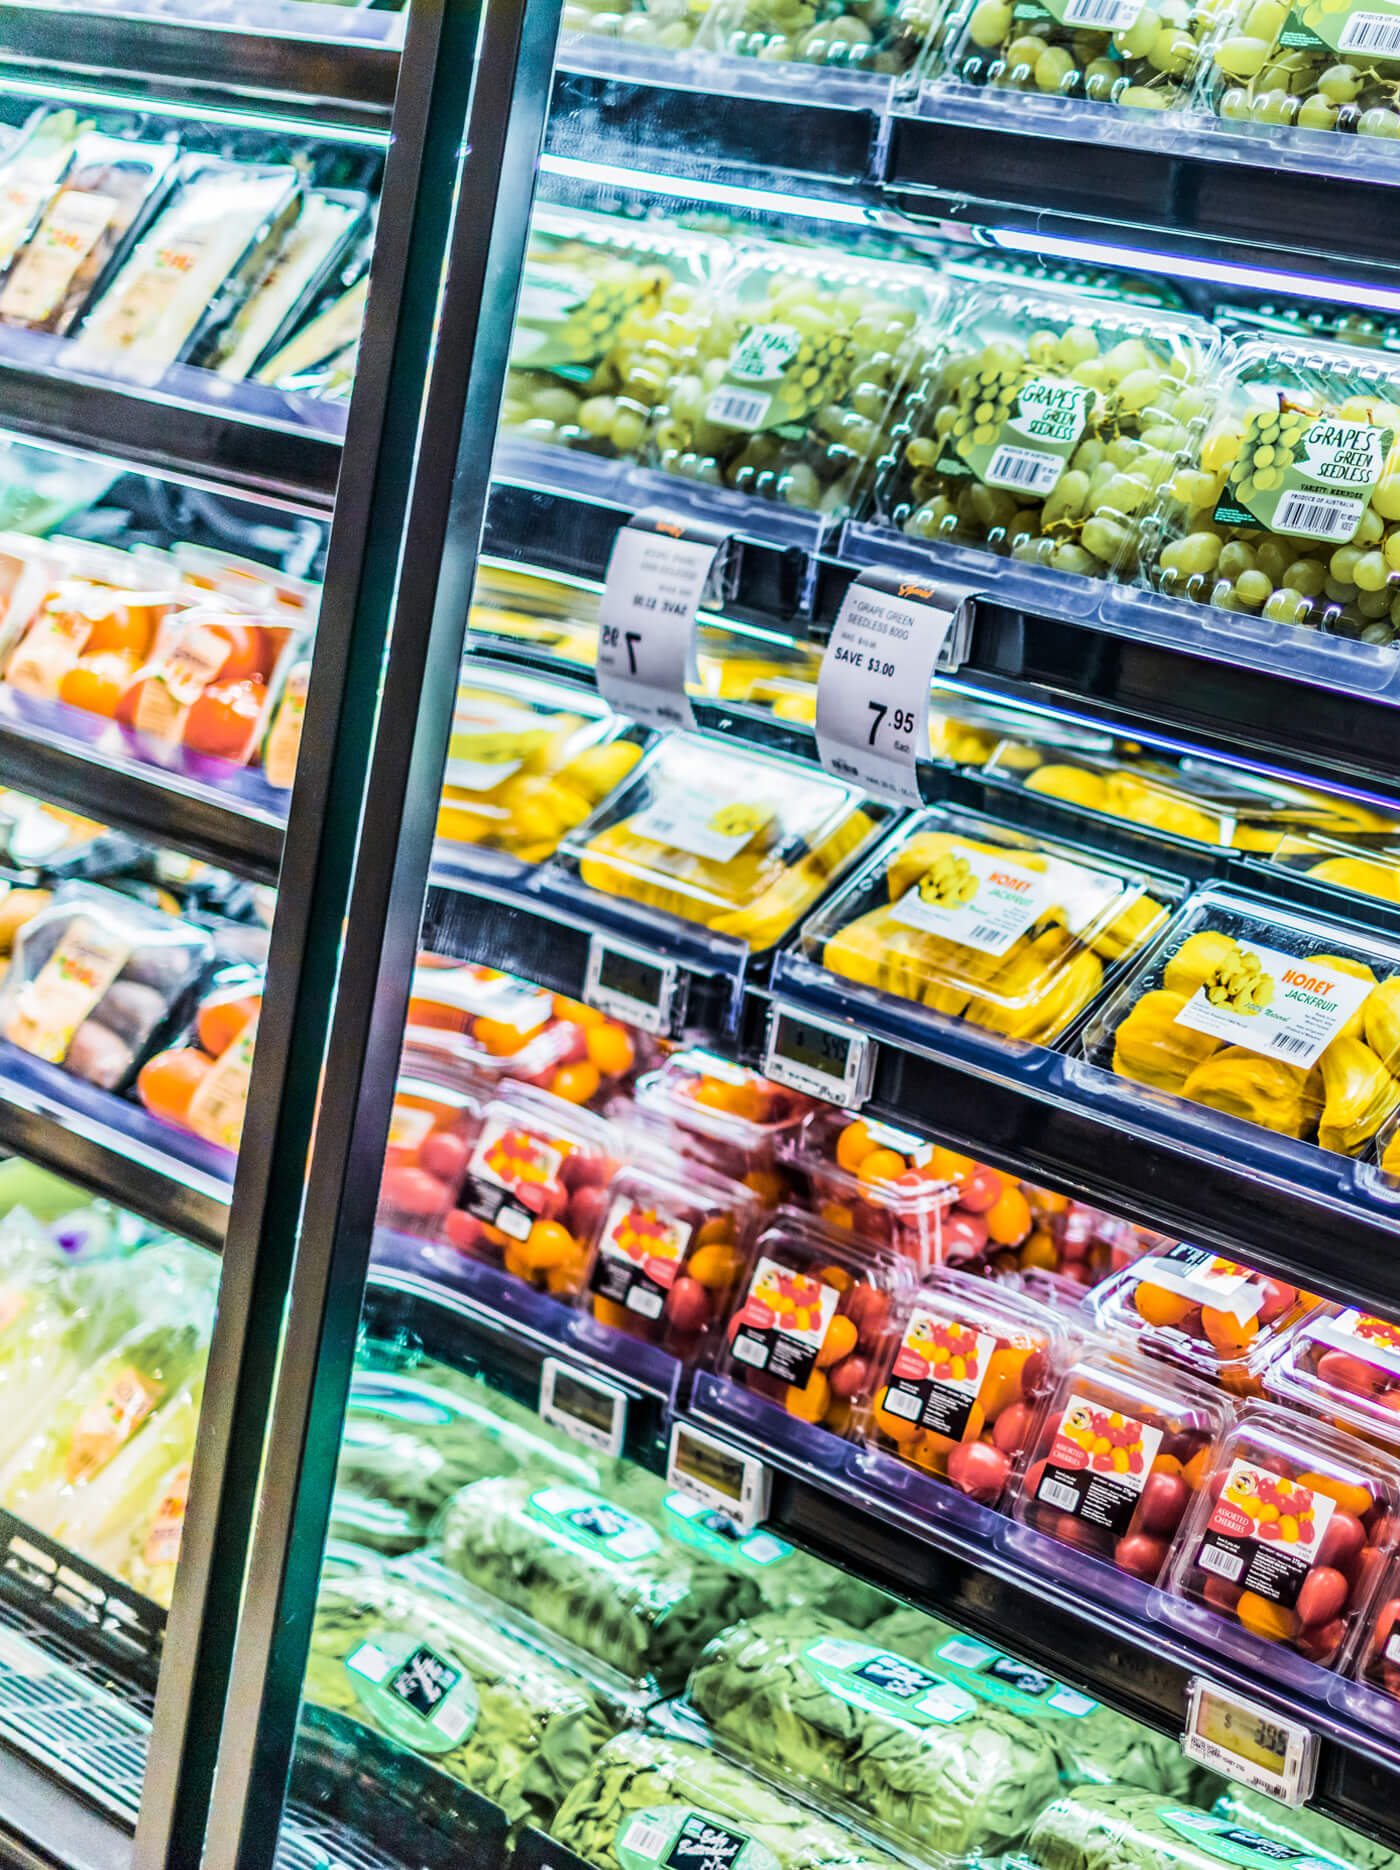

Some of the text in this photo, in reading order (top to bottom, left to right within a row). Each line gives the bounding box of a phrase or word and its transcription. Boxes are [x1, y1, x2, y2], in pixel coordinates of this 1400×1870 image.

[1022, 384, 1081, 410] GRAPES
[1043, 409, 1077, 426] GREEN
[1027, 420, 1076, 440] SEEDLESS
[1308, 425, 1376, 451] GRAPES
[1334, 450, 1374, 468] GREEN
[1317, 462, 1373, 484] SEEDLESS
[1291, 493, 1315, 503] PRODUCE
[1325, 498, 1354, 508] AUSTRALIA
[848, 613, 888, 634] SEEDLESS
[857, 602, 915, 626] GRAPE GREEN
[834, 647, 895, 677] SAVE $3.00
[988, 872, 1032, 892] HONEY
[1281, 969, 1335, 996] HONEY
[1284, 989, 1338, 1013] JACKFRUIT
[1214, 1515, 1245, 1533] CHERRIES
[1217, 1508, 1249, 1526] ASSORTED
